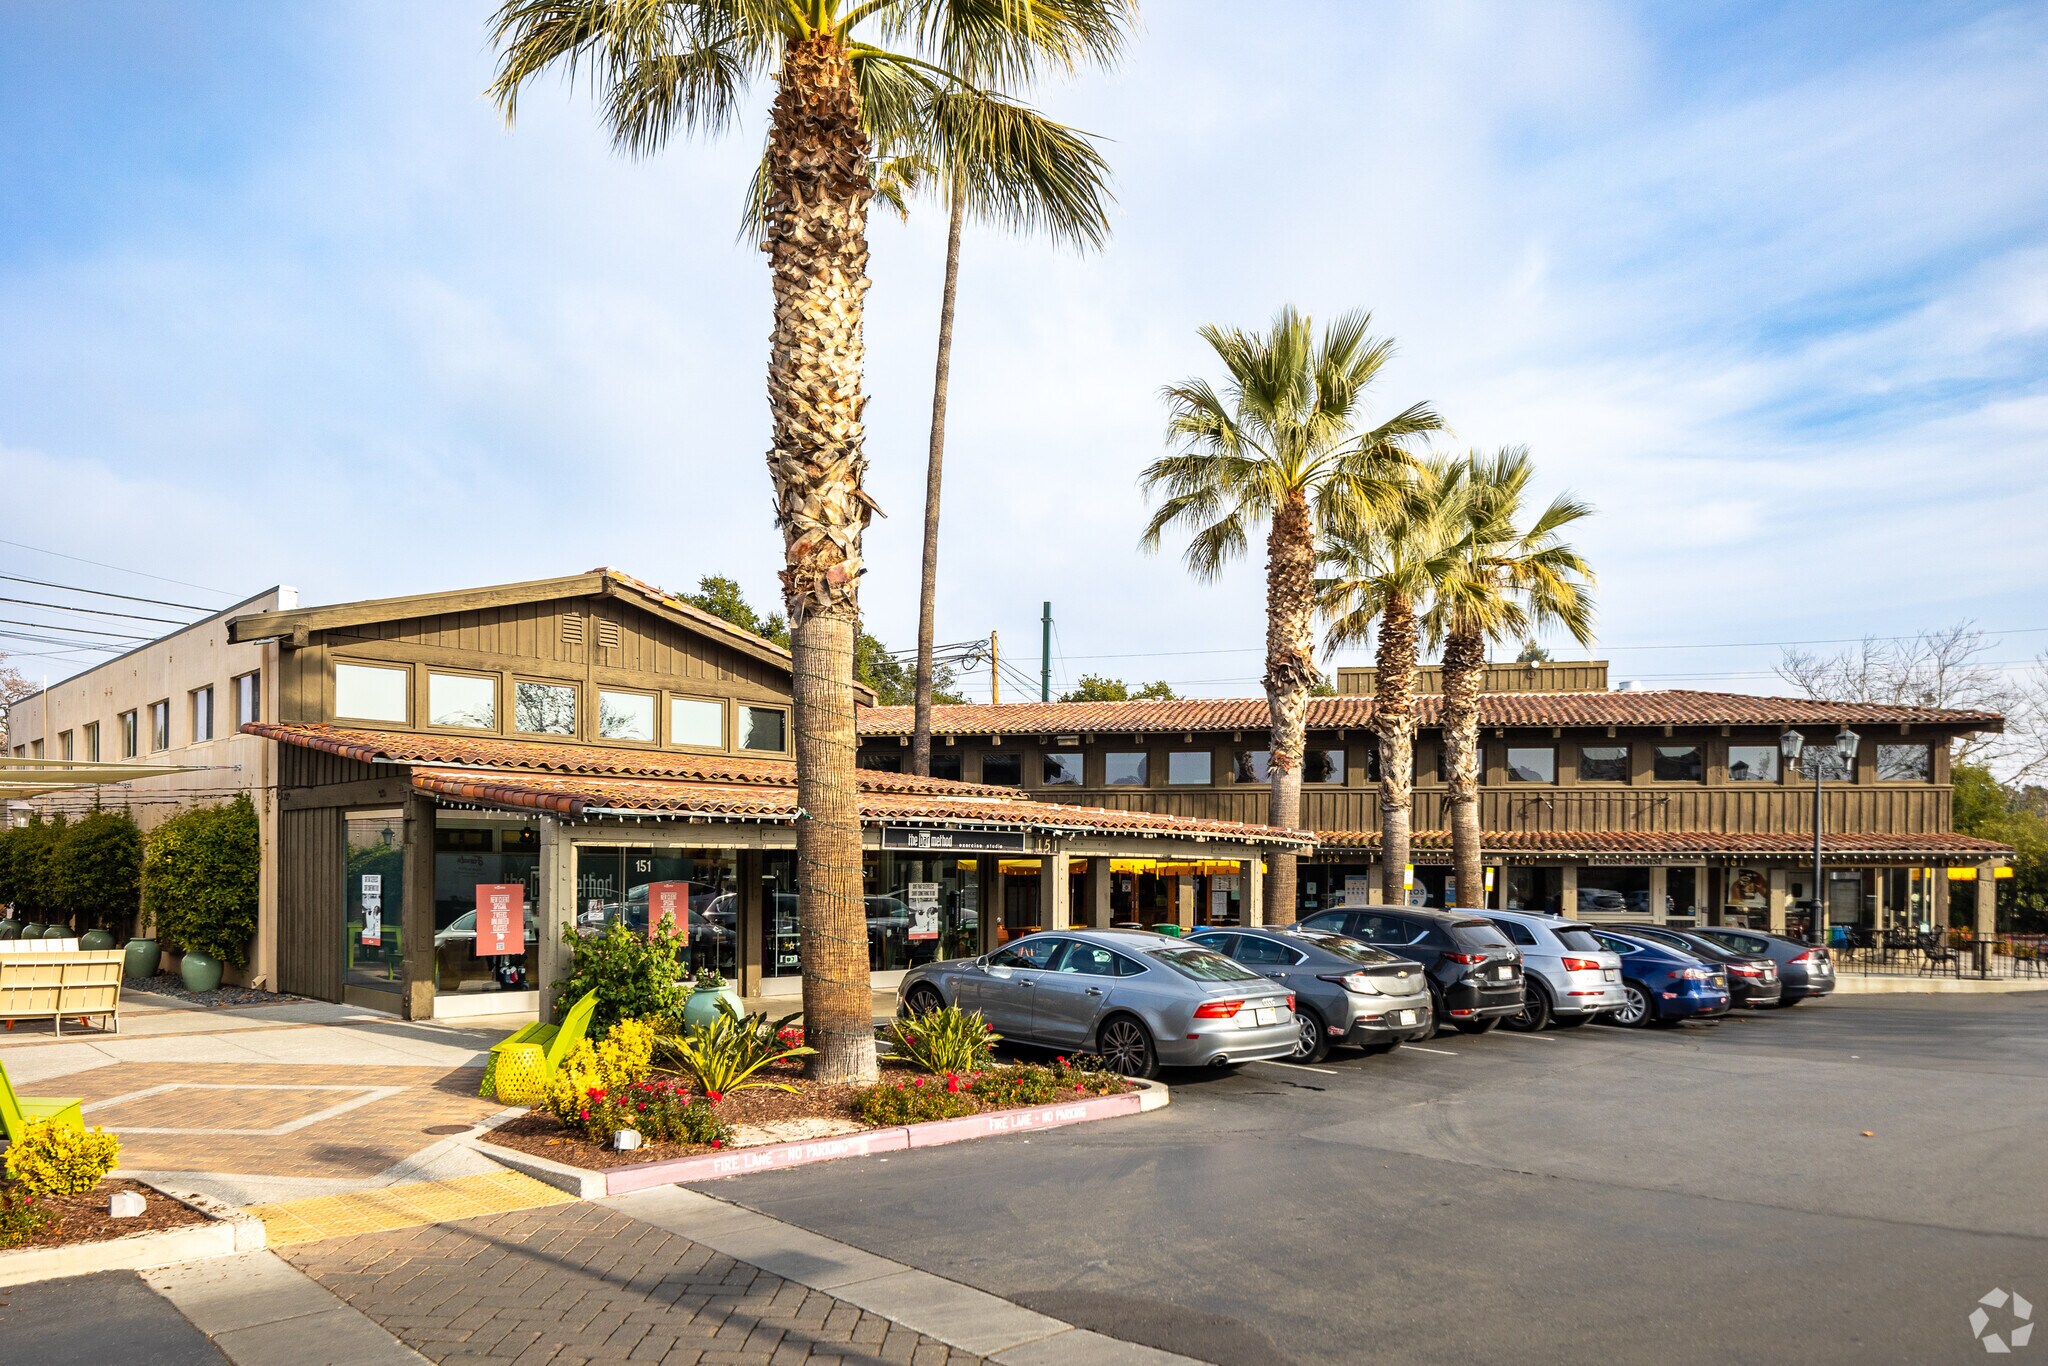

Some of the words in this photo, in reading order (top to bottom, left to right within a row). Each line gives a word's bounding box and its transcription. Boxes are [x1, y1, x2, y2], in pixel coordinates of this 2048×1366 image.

[908, 833, 918, 847] the
[919, 831, 930, 848] bar
[931, 834, 953, 848] method
[1037, 838, 1057, 852] 151
[635, 859, 651, 873] 151
[1320, 855, 1340, 863] 158
[577, 873, 613, 898] ethod
[989, 1118, 1008, 1131] FIRE
[1011, 1113, 1032, 1127] LANE
[1042, 1111, 1053, 1123] NO
[1055, 1106, 1087, 1120] PARKING
[713, 1157, 740, 1173] FIRE
[743, 1152, 773, 1168] LANE
[787, 1147, 803, 1161] NO
[806, 1140, 849, 1158] PARKING
